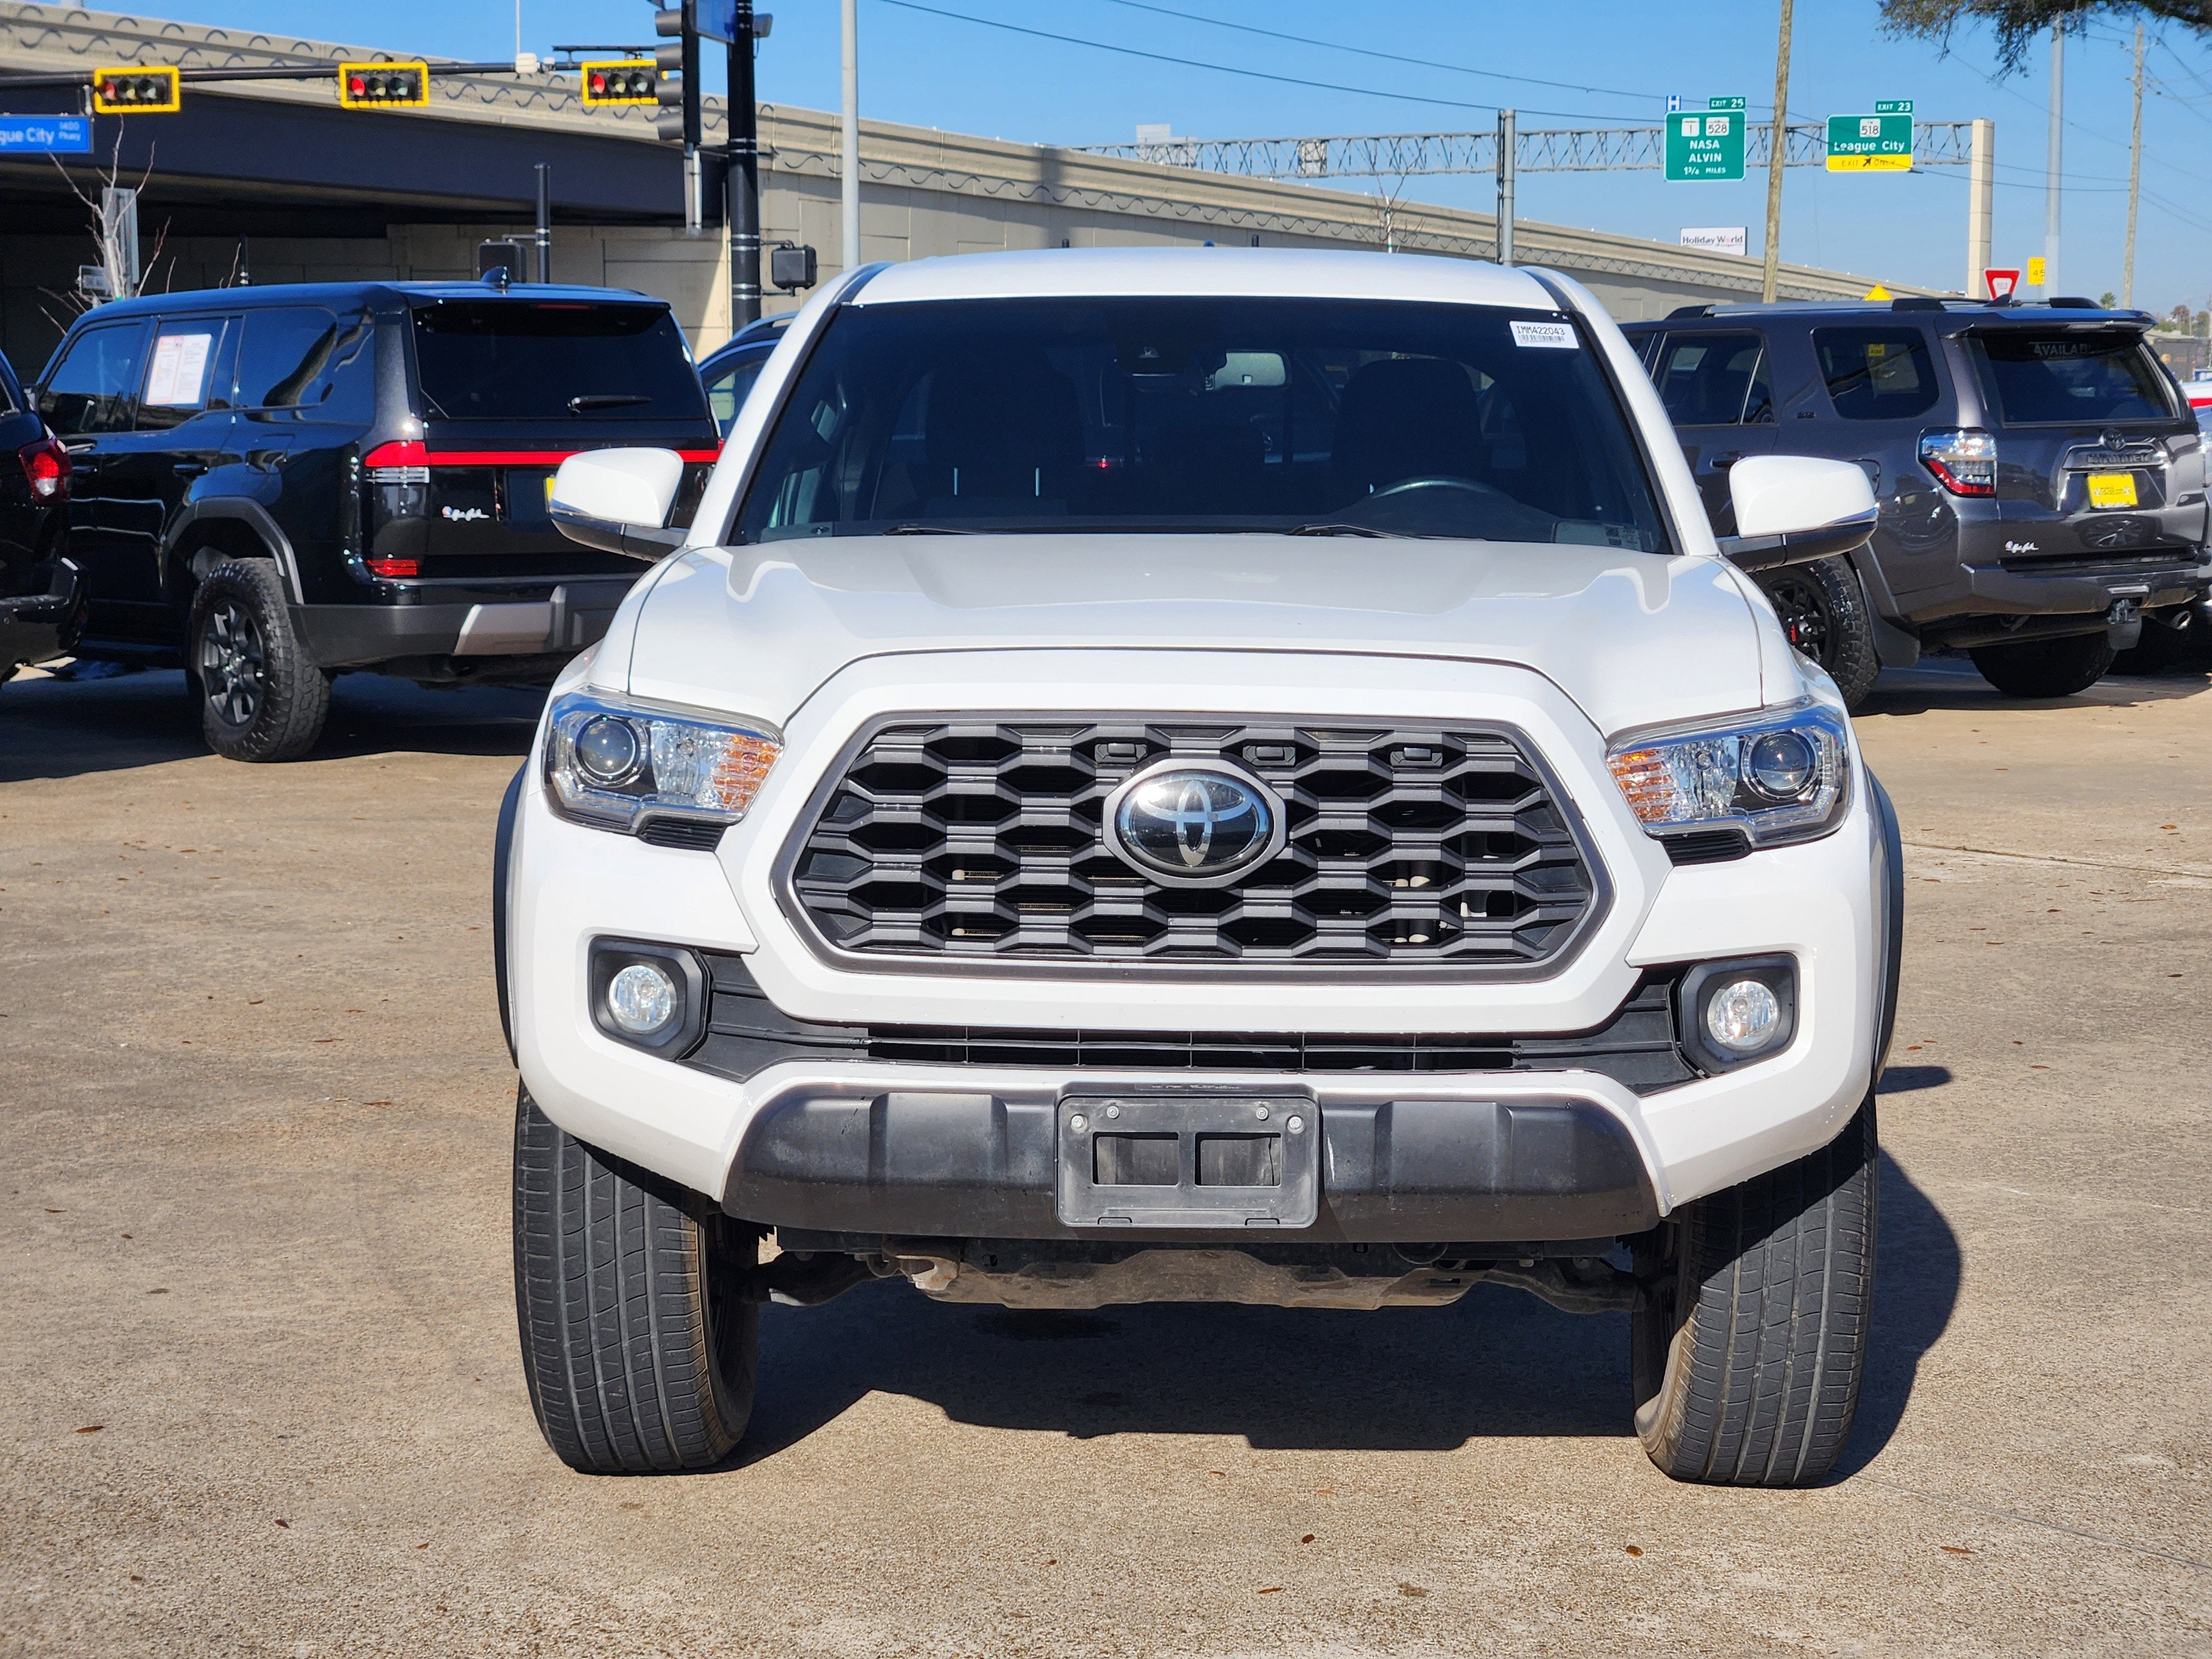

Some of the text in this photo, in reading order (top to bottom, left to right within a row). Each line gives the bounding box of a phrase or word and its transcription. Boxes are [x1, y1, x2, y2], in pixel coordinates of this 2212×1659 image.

[1731, 98, 1744, 107] 25
[1897, 102, 1911, 111] 23
[1708, 124, 1727, 134] 528
[1861, 126, 1879, 135] 518
[25, 127, 55, 145] City
[1689, 139, 1720, 150] NASA
[1833, 140, 1905, 154] League City
[1688, 153, 1722, 163] ALVIN
